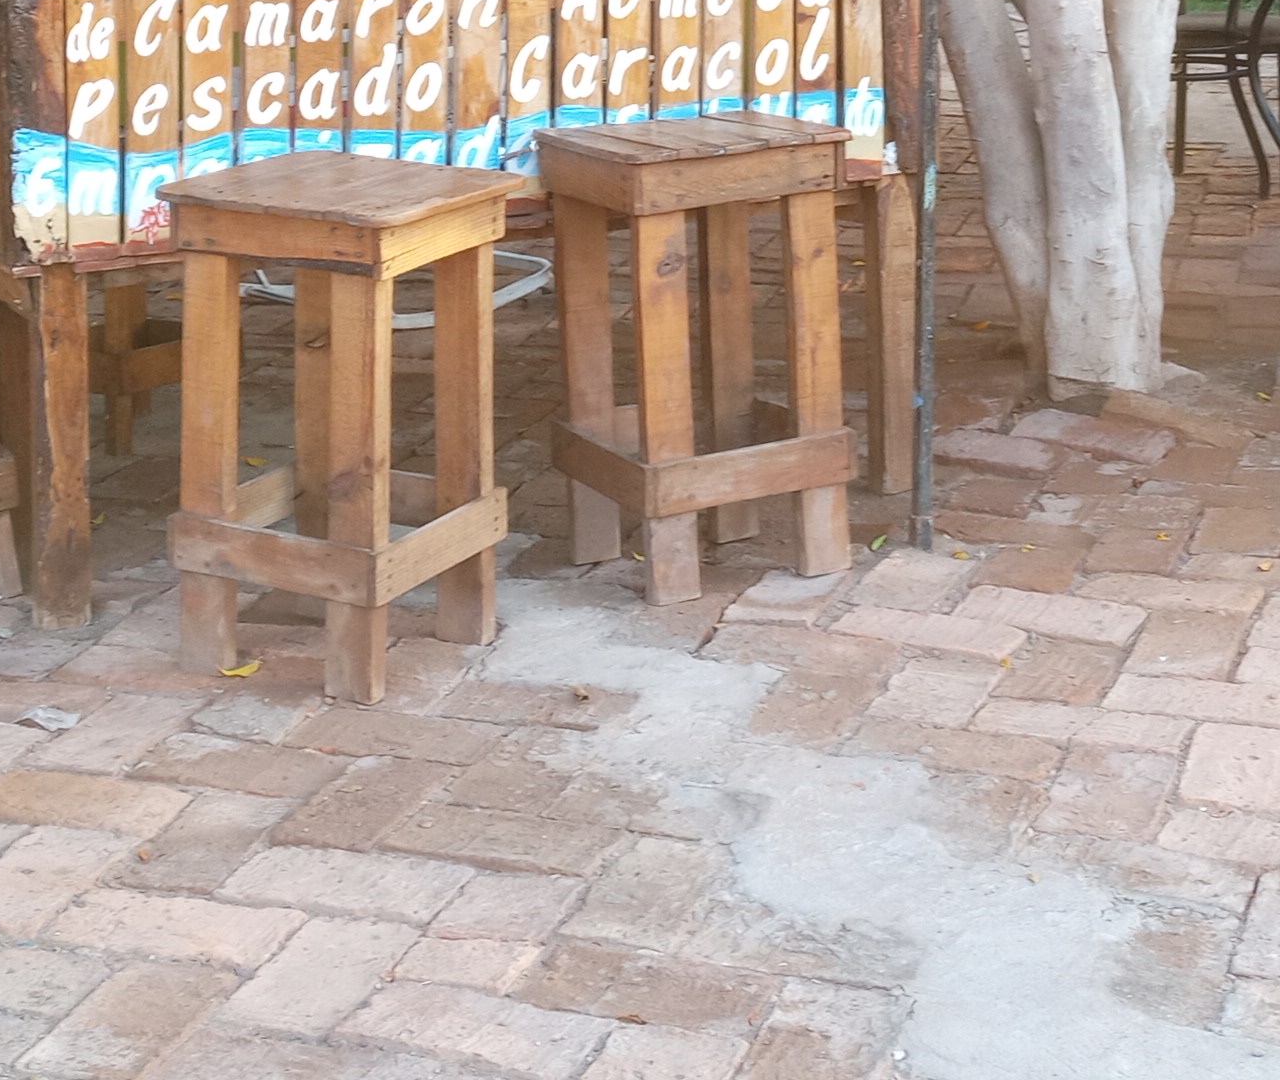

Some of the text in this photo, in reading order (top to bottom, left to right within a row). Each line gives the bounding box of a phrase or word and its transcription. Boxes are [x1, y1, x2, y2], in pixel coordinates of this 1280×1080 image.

[66, 1, 115, 64] de
[67, 6, 831, 140] Pescado Caracol
